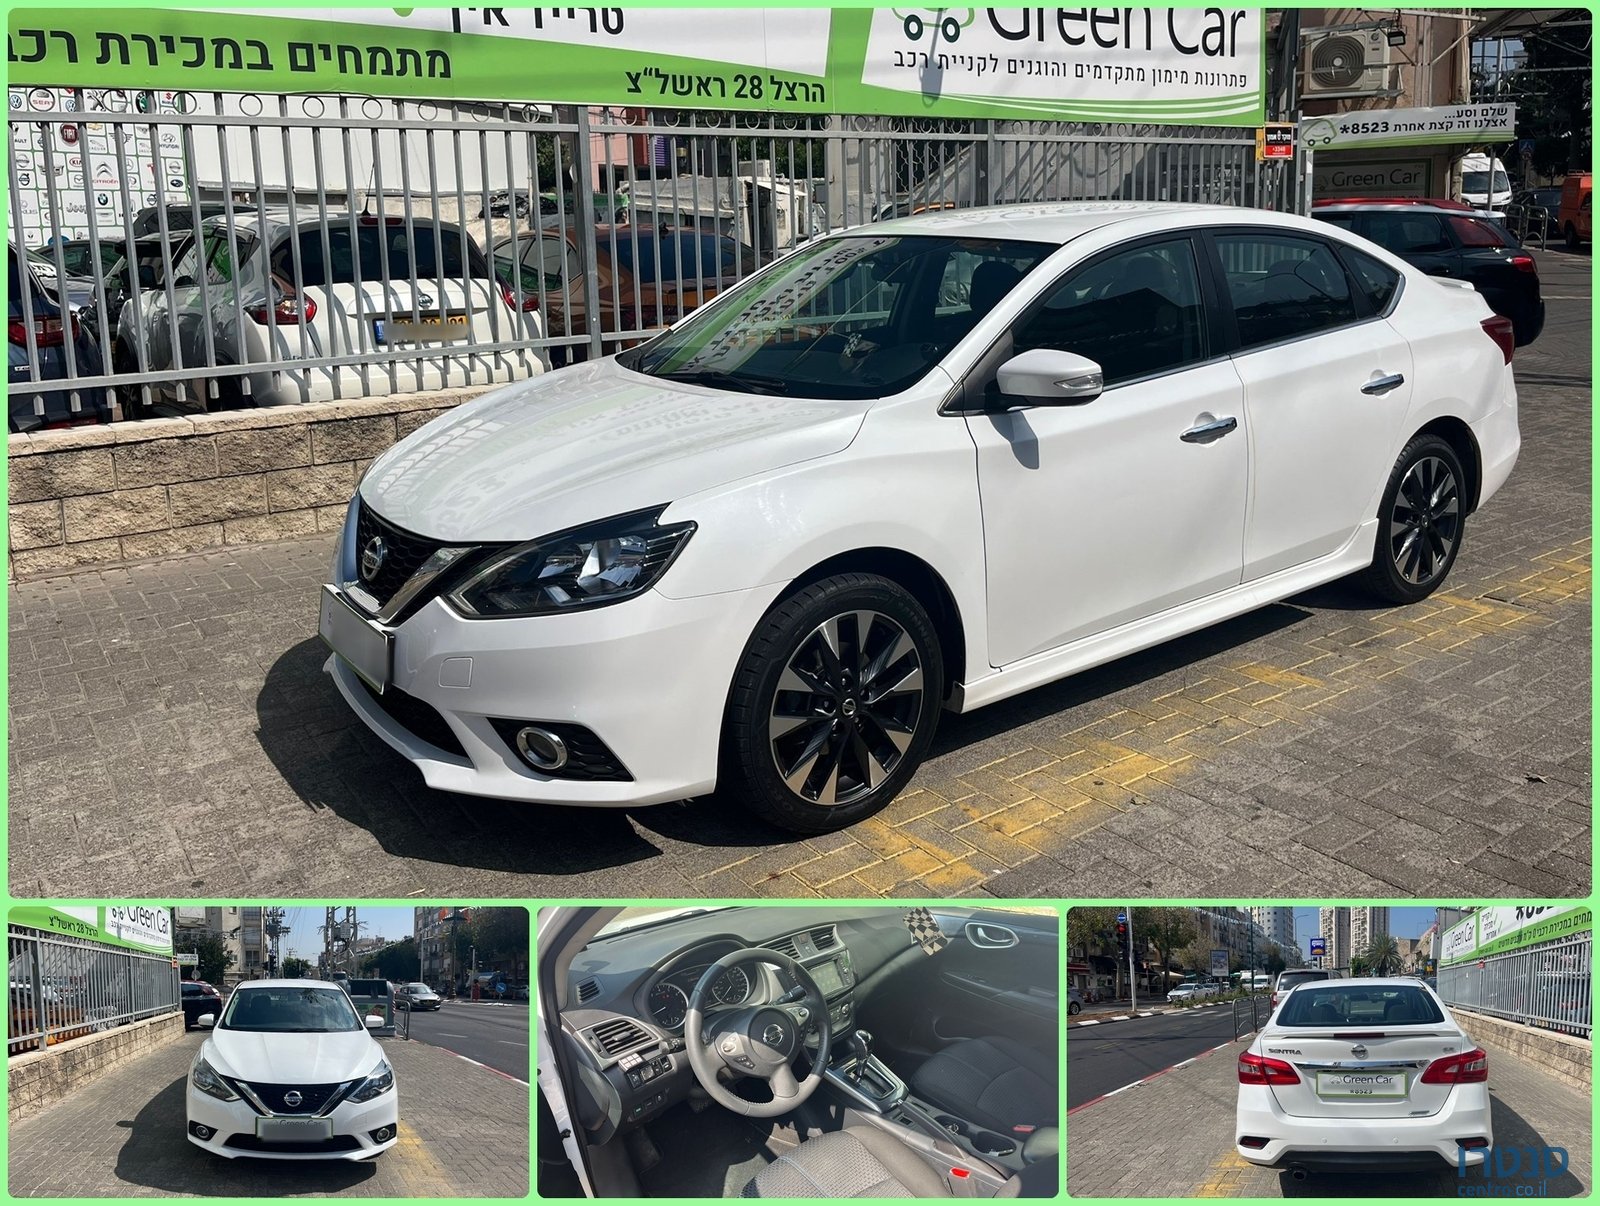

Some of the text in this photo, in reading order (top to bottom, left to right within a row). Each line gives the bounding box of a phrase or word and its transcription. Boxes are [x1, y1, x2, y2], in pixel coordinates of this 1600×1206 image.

[1167, 8, 1246, 58] Car
[96, 31, 274, 71] במכירת
[288, 42, 452, 79] מתמחים
[893, 50, 1248, 88] פתרונות מימון מתקדמים והוגנים לקניית רכב
[733, 74, 763, 100] 28
[769, 75, 826, 103] הרצל
[1480, 106, 1508, 117] שלם
[1393, 122, 1426, 133] אחרת
[1428, 121, 1453, 132] קצת
[1457, 120, 1471, 129] זה
[1474, 118, 1508, 128] אצלנו
[1331, 169, 1420, 188] Green Car
[76, 920, 85, 933] 28
[1267, 1048, 1303, 1056] SENTRA
[1343, 1075, 1393, 1084] Green Car
